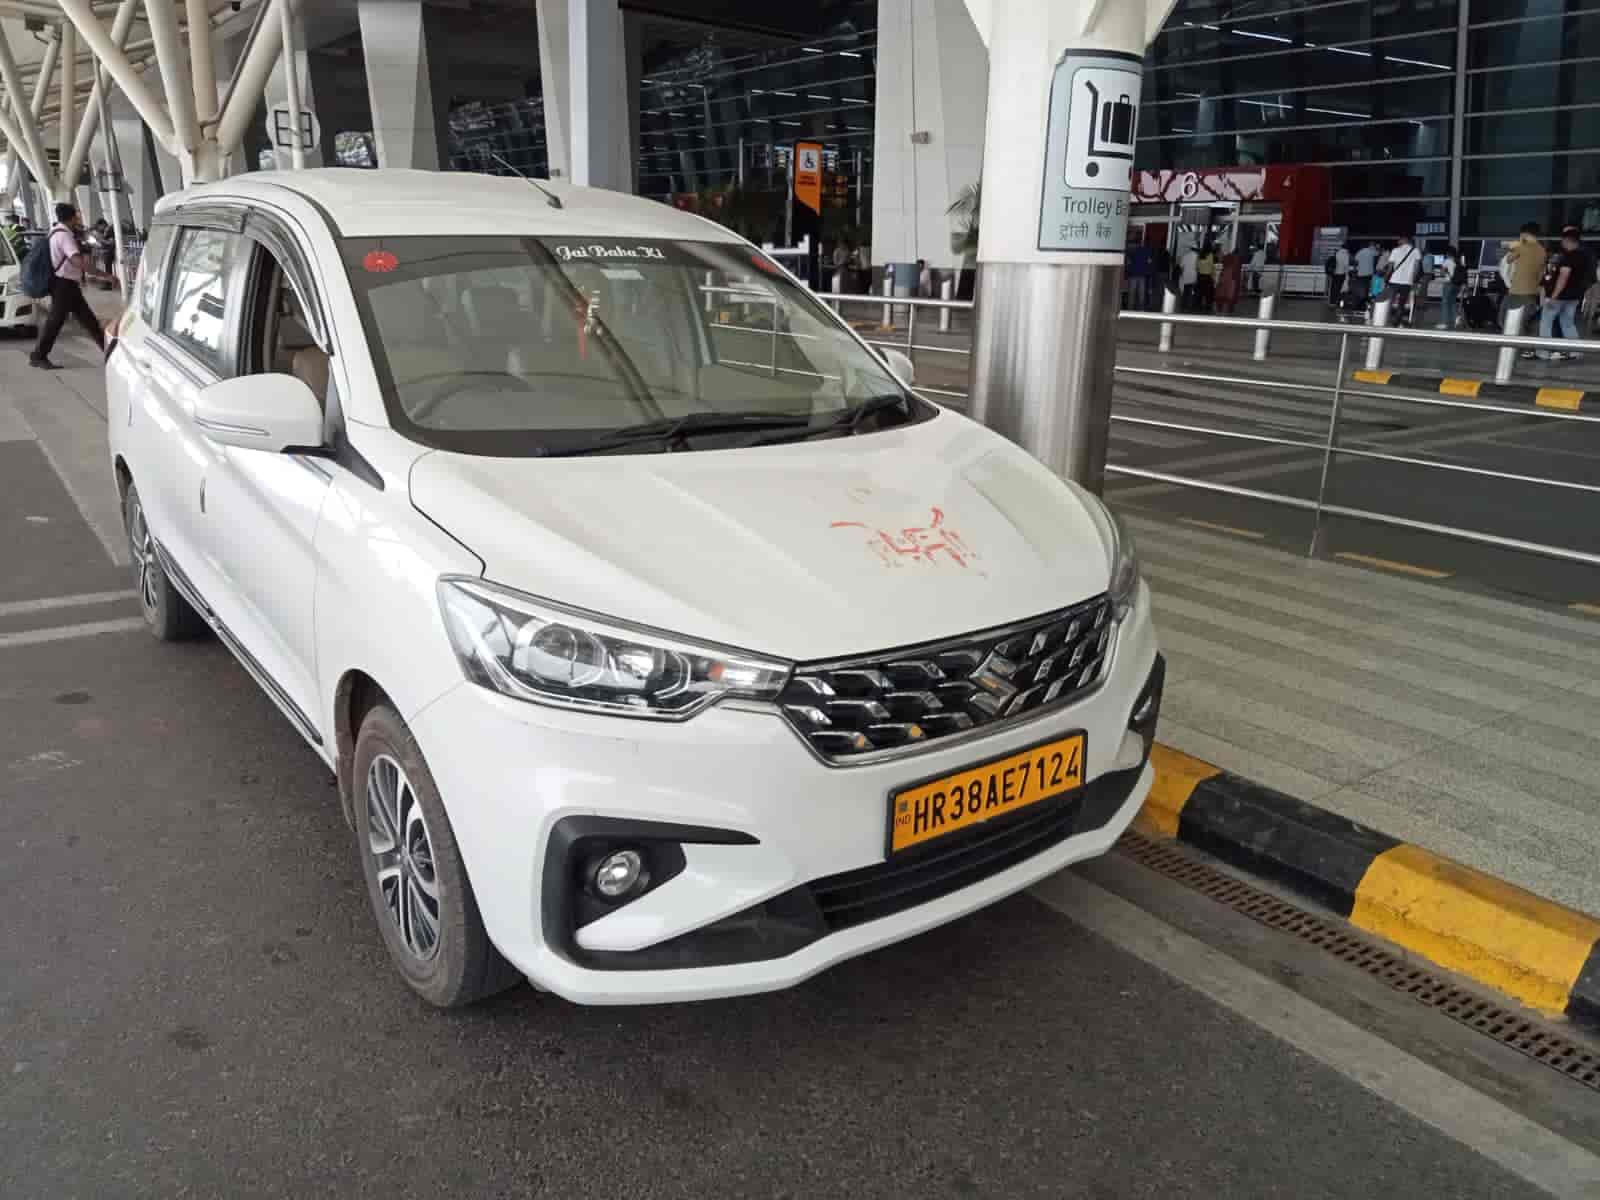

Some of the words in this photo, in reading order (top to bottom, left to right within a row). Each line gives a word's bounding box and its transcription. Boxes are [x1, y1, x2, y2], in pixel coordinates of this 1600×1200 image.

[1062, 196, 1113, 219] Trolley
[556, 245, 588, 261] Jai
[588, 245, 637, 257] Baba
[912, 745, 1079, 836] HR38AE7124
